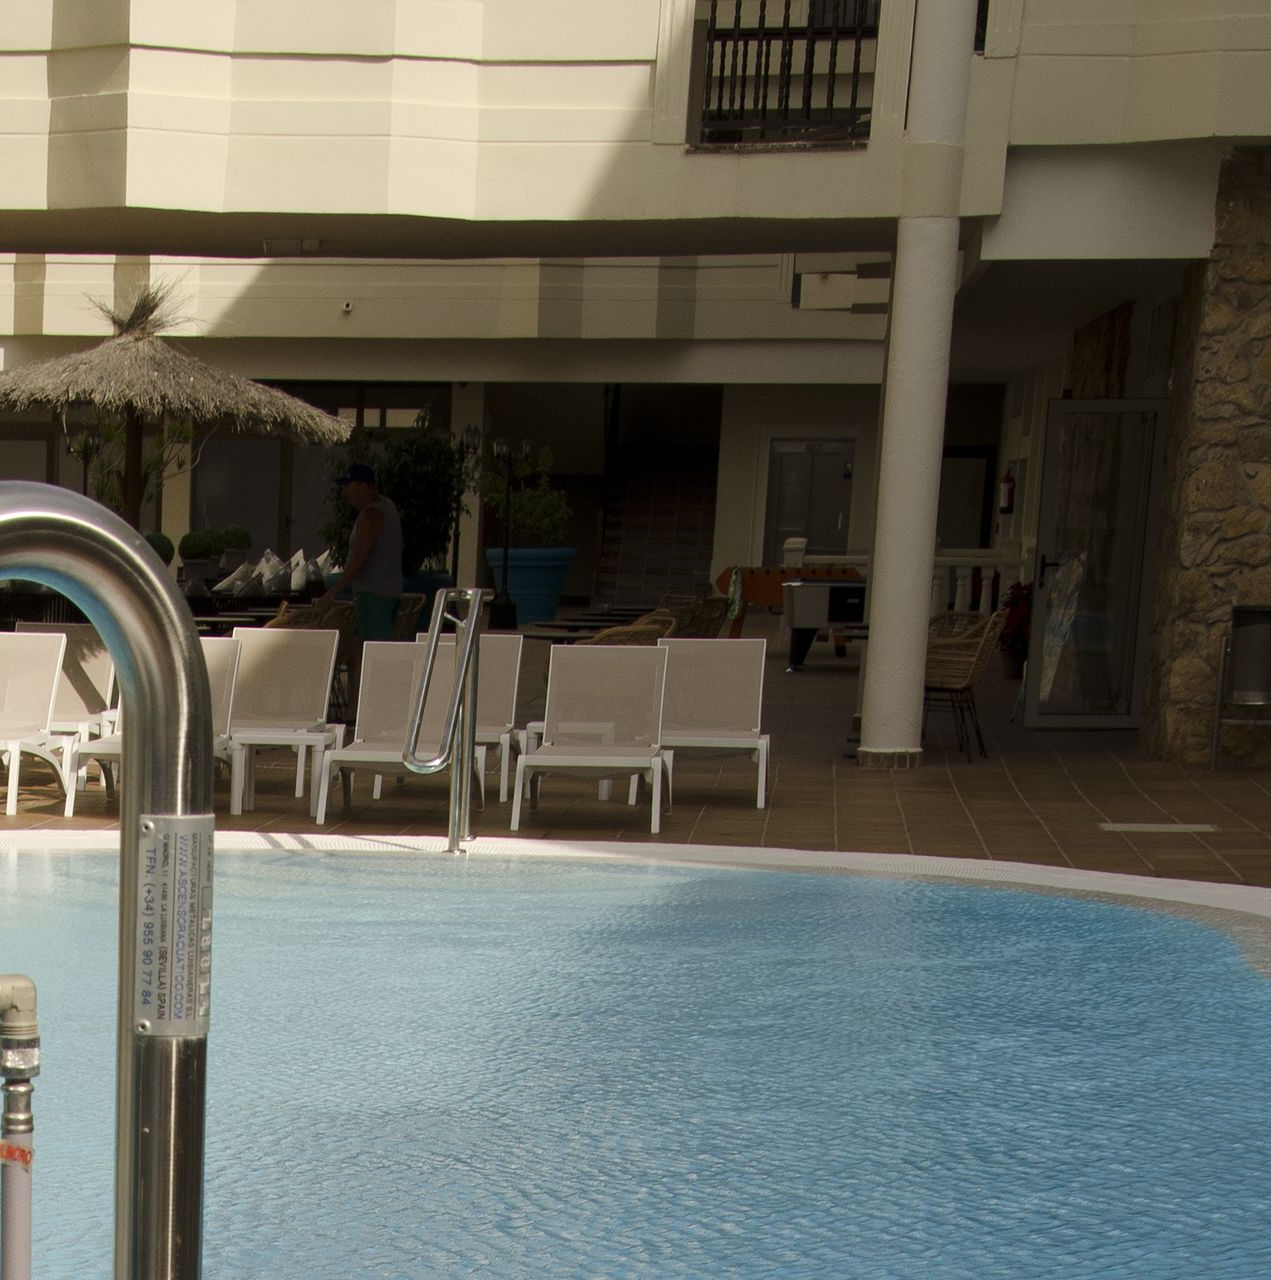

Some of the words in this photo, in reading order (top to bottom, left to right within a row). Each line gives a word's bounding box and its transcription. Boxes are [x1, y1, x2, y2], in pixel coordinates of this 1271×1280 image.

[145, 847, 157, 878] TFN.
[190, 833, 199, 900] MANUFACTURAS
[142, 883, 155, 917] (+34)
[143, 921, 154, 945] 955
[142, 949, 153, 966] 90
[157, 946, 169, 990] (SEVILLA)
[142, 970, 152, 986] 77
[141, 990, 152, 1006] 84
[157, 992, 167, 1020] SPAIN
